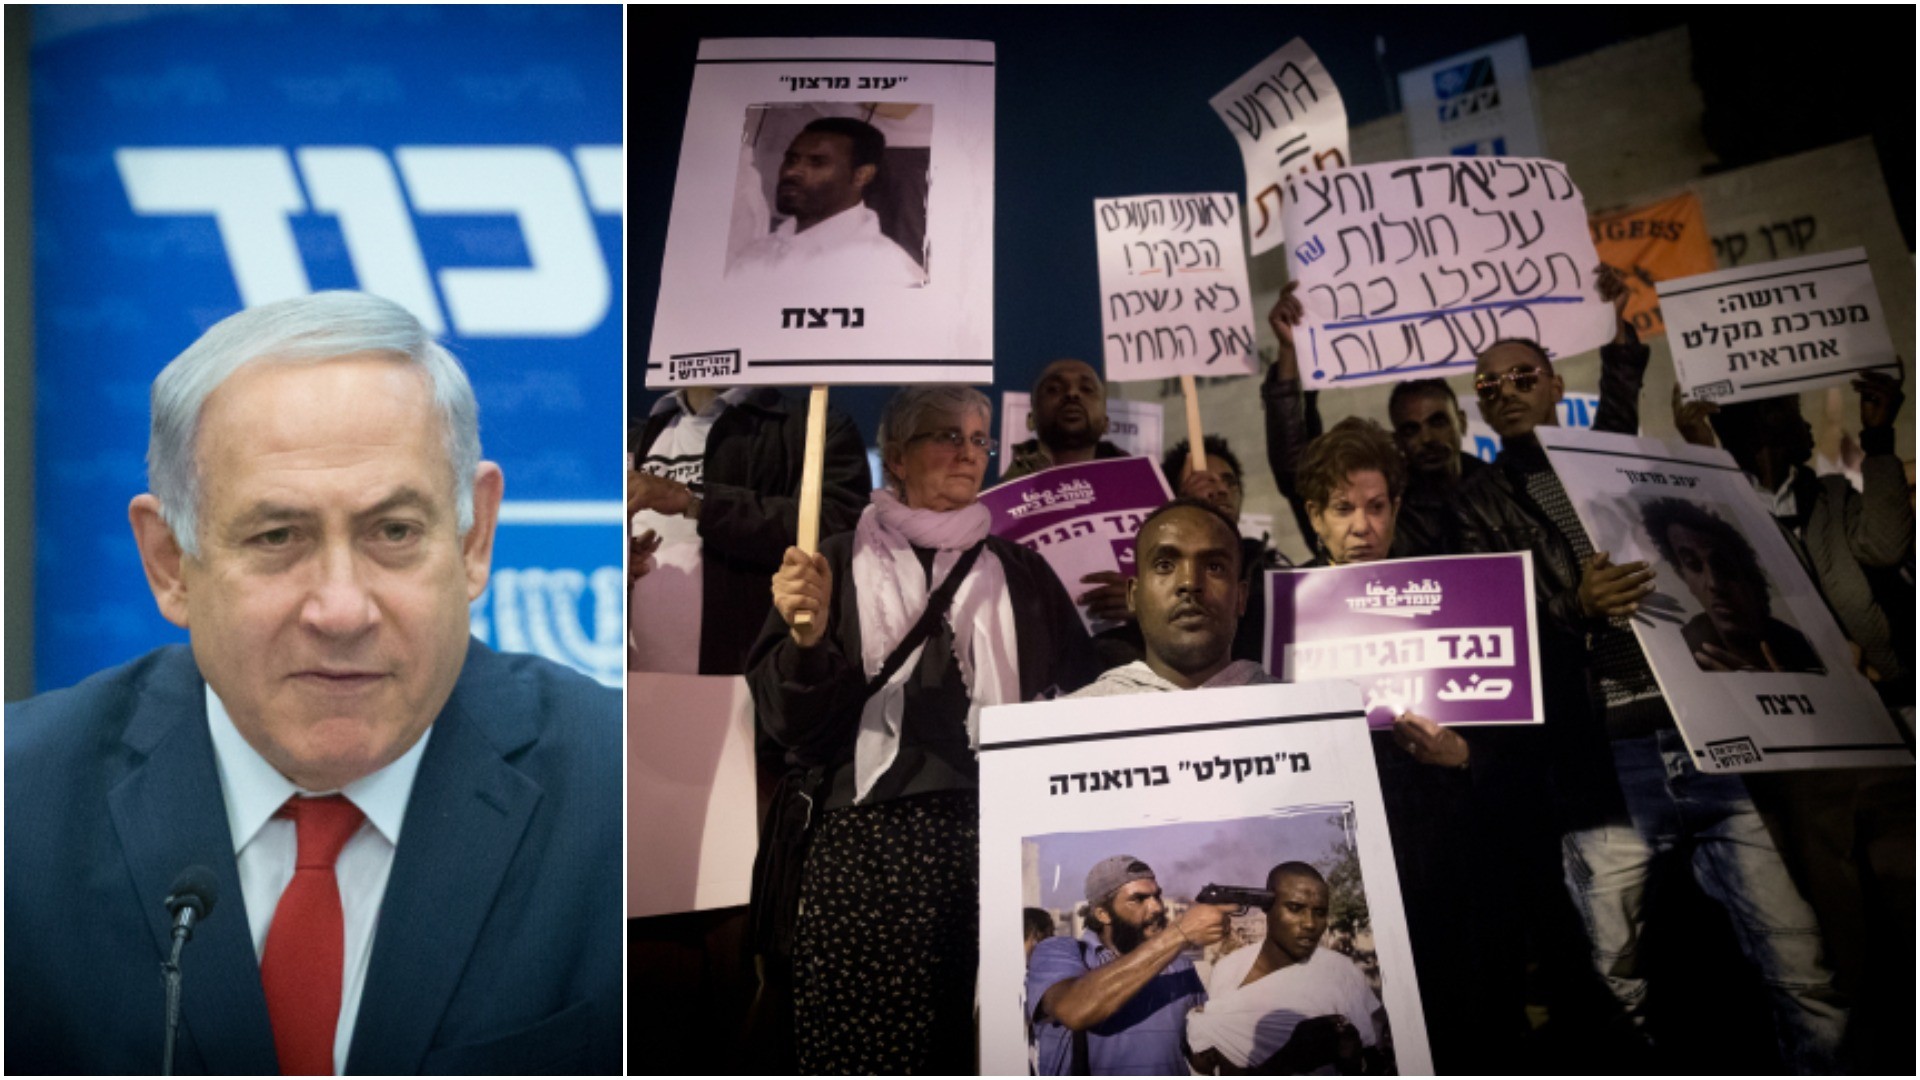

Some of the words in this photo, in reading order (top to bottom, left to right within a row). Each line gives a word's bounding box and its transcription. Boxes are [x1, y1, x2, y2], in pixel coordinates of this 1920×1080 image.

[1226, 61, 1318, 141] גירוש
[1290, 171, 1376, 225] וחצי
[1391, 159, 1574, 209] מיליארד
[1333, 212, 1460, 277] חולות
[1472, 207, 1544, 252] על
[1759, 215, 1816, 259] קרן
[1712, 233, 1747, 268] קי
[1420, 252, 1582, 309] תטפלו
[1110, 288, 1183, 321] נשכח
[1194, 282, 1240, 313] לא
[1308, 276, 1398, 321] כבר
[1718, 282, 1817, 313] דרושה:
[781, 306, 865, 329] נרצח
[1682, 319, 1763, 349] מקלט
[1772, 304, 1870, 335] מערכת
[1206, 325, 1252, 365] את
[1727, 338, 1840, 372] אחראית
[1437, 633, 1504, 661] נגד
[1437, 673, 1513, 701] ضد
[1755, 693, 1817, 716] נרצח
[1049, 765, 1171, 796] ברואנדה
[1179, 751, 1312, 784] מ"מקלט"
